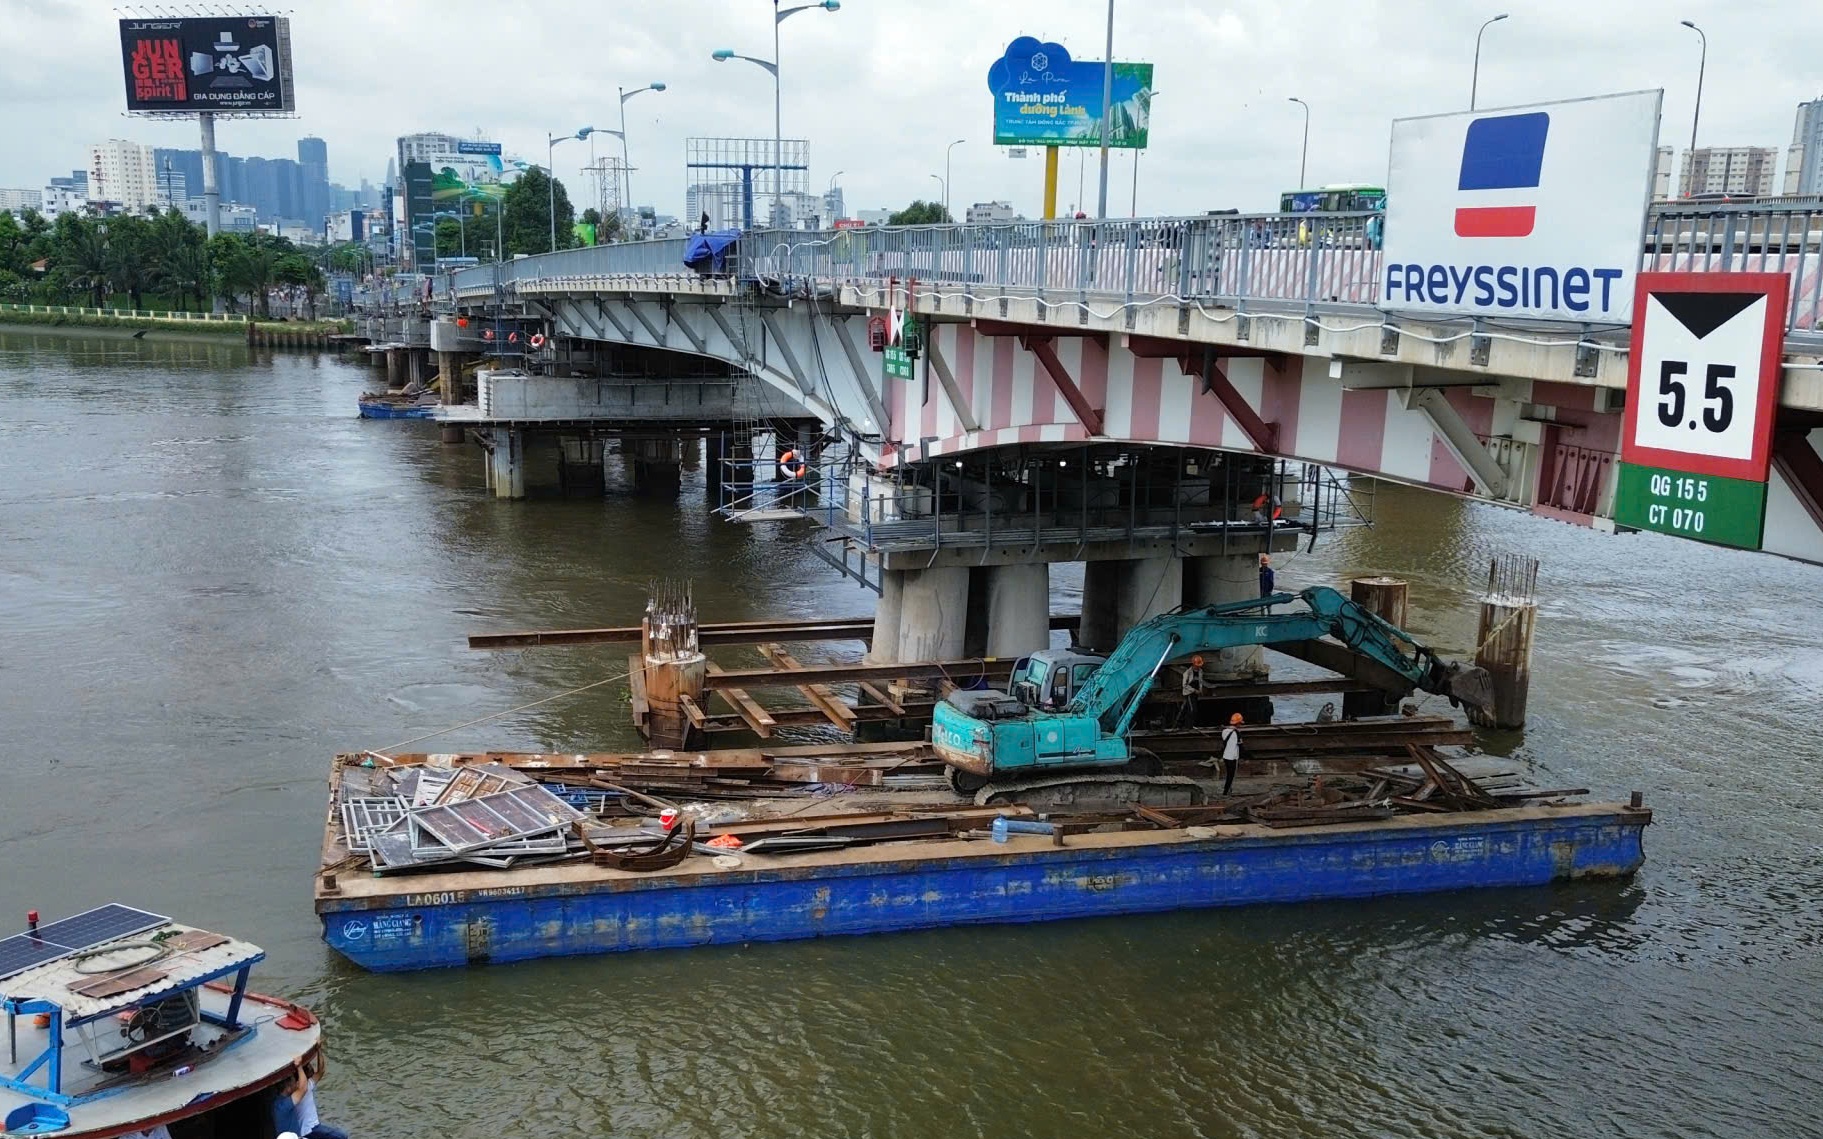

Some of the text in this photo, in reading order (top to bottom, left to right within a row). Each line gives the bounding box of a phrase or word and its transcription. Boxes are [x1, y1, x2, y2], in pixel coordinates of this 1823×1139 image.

[137, 86, 171, 101] spirit
[209, 93, 232, 102] DỤNG
[1005, 90, 1067, 104] Thành phố
[1658, 361, 1735, 433] 5.5
[1650, 474, 1671, 497] QG
[1648, 504, 1704, 533] CT 070
